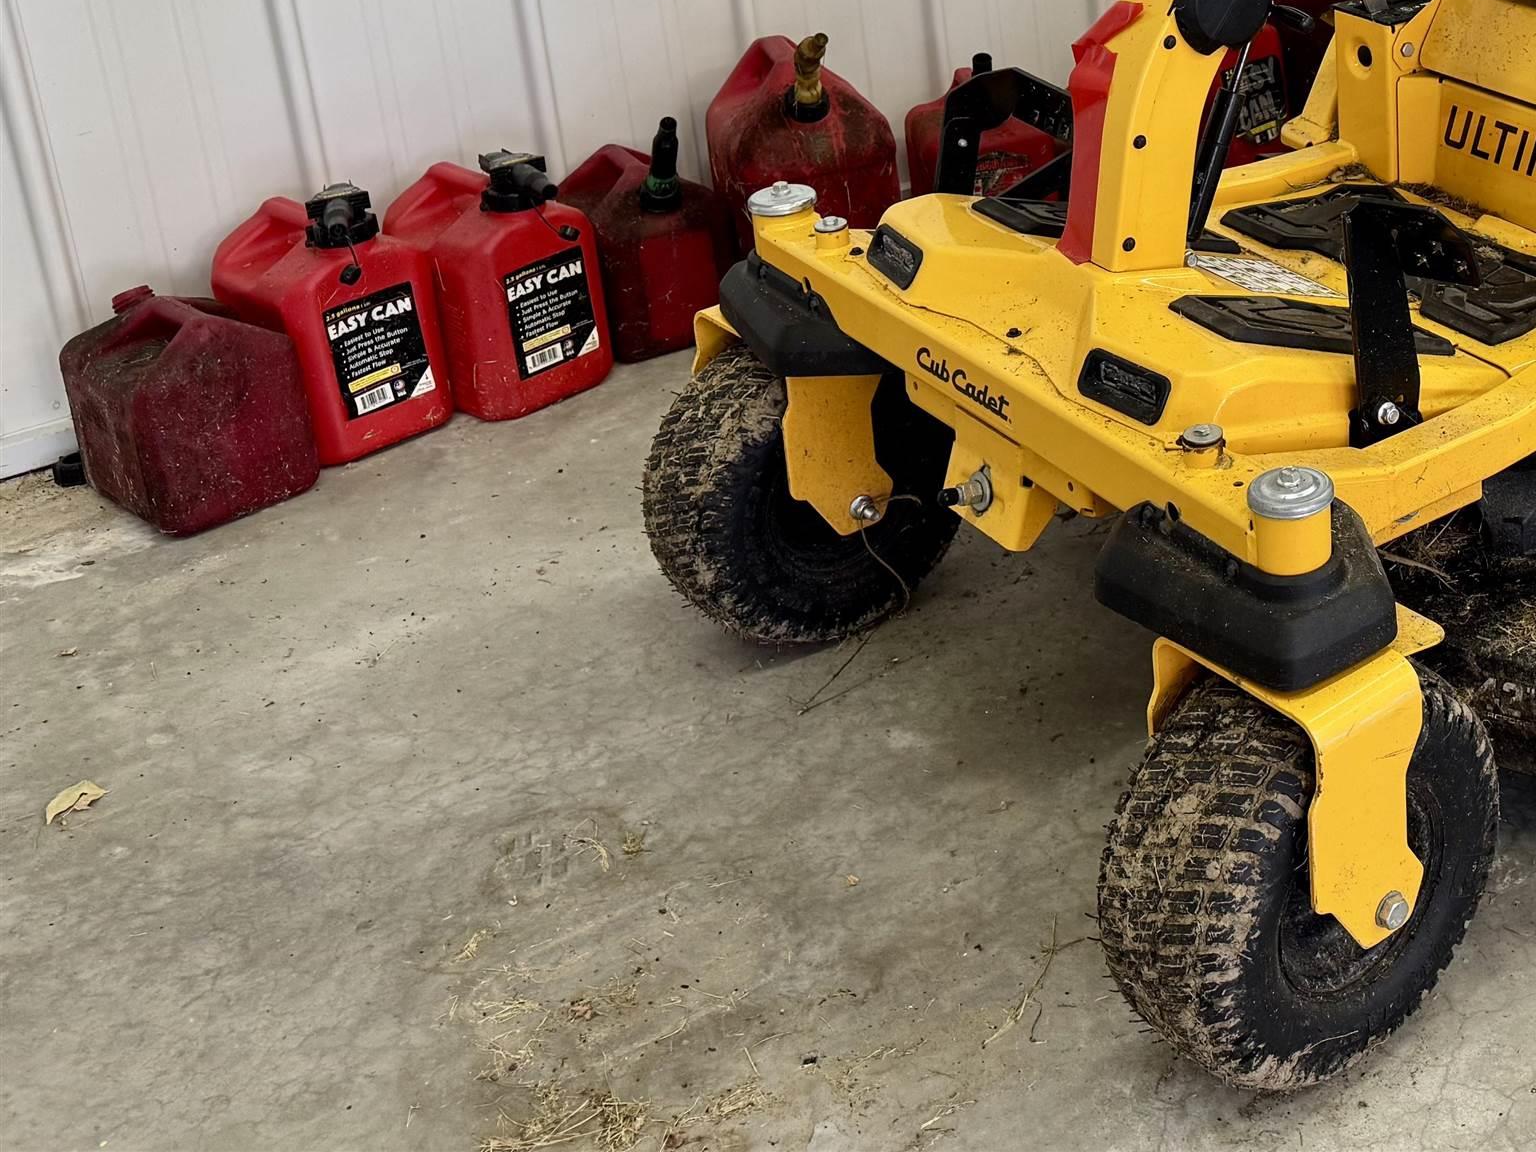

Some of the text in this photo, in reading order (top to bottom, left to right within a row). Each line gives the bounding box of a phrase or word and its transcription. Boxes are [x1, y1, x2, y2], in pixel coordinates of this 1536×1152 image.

[507, 260, 583, 303] EASY CAN
[520, 296, 540, 308] Easiest
[547, 289, 558, 298] Use
[521, 289, 578, 316] Just Press the Button
[327, 296, 413, 341] EASY CAN
[522, 312, 541, 324] Simple
[548, 300, 572, 313] Accurate
[524, 310, 566, 330] Automatic Stop
[343, 327, 385, 348] Easiest to Use
[346, 327, 409, 356] Just Press the Button
[525, 321, 559, 338] Fastest Flow
[347, 350, 367, 363] Simple
[374, 337, 401, 351] Accurate
[349, 348, 394, 371] Automatic Stop
[351, 359, 387, 378] Fastest Flow
[916, 346, 1010, 422] Cub Cadet
